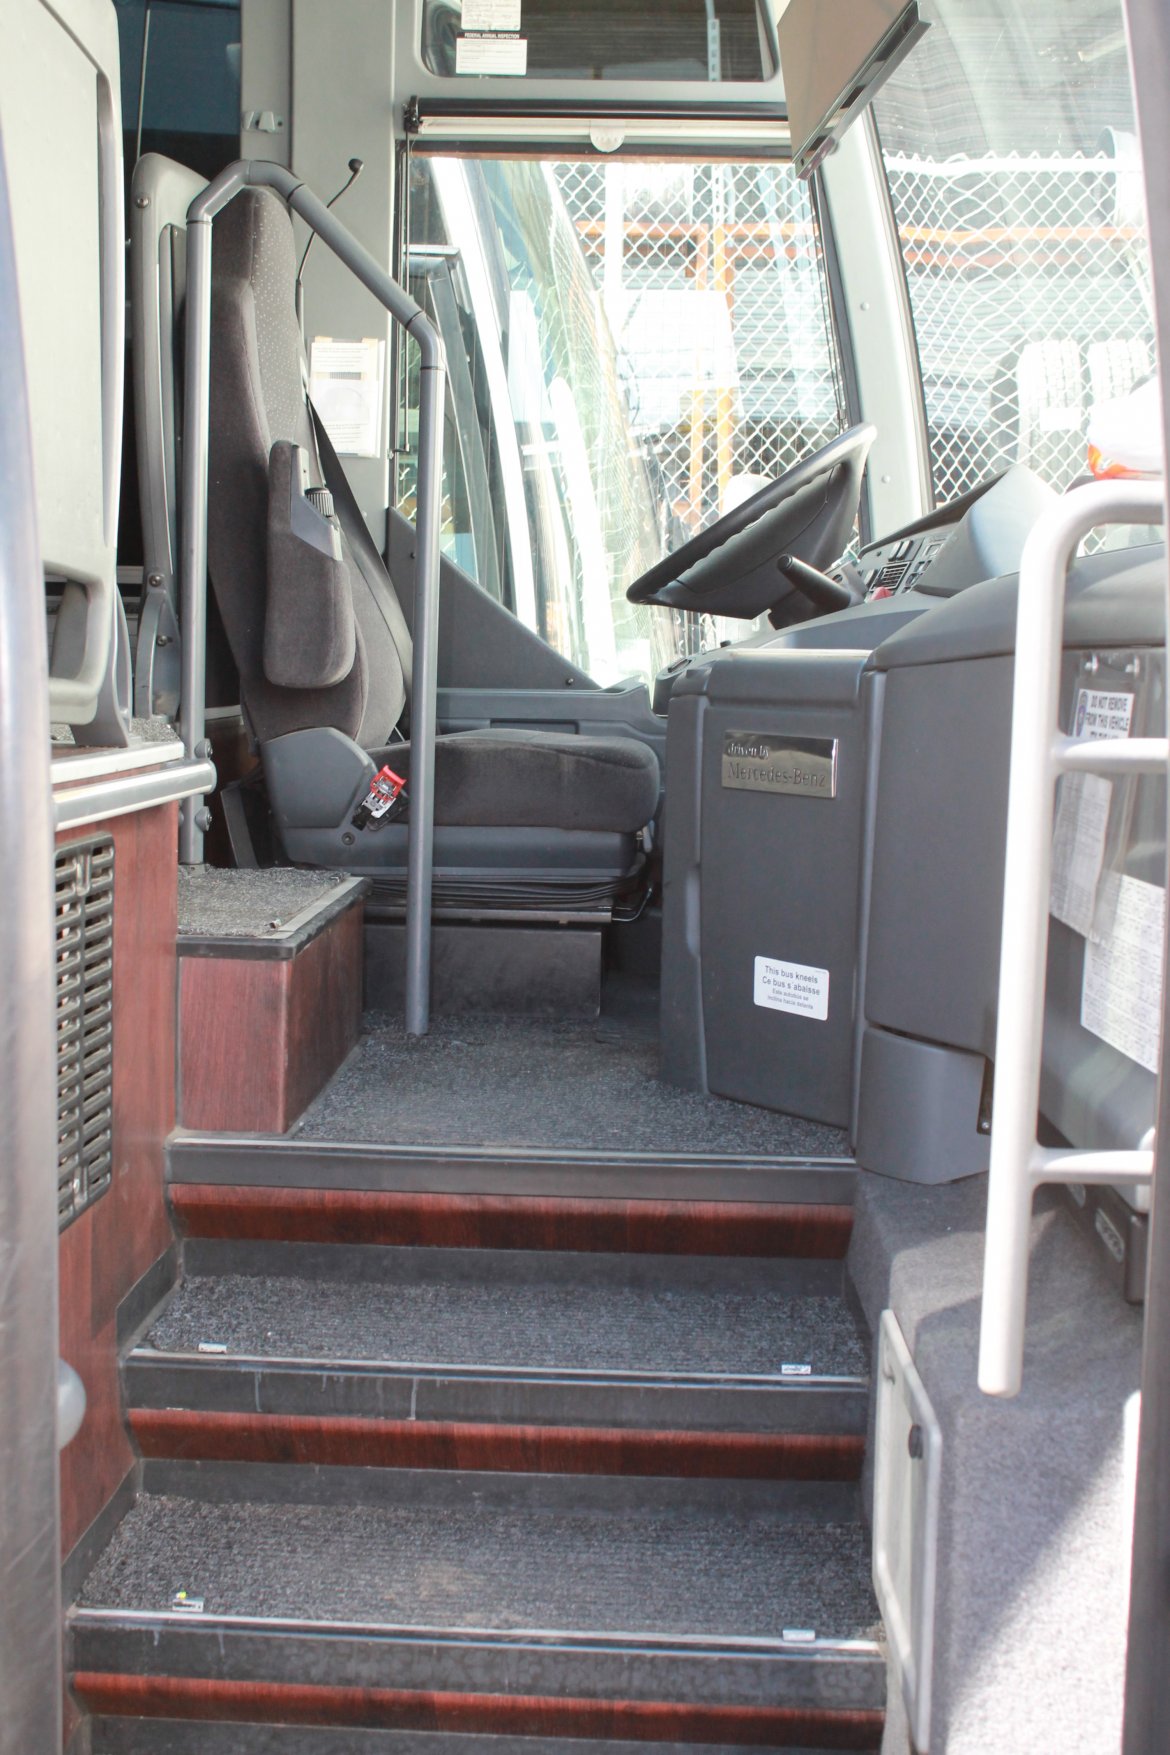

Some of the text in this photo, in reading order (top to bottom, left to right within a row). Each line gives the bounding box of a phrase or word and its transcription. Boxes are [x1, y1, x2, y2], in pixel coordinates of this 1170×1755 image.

[1091, 695, 1128, 712] DO NOT REMOVE
[1086, 712, 1130, 732] FROM THIS VEHICLE
[728, 761, 825, 787] Mercedes-Benz
[762, 975, 772, 985] Ce
[773, 978, 786, 988] bus
[765, 965, 779, 976] This
[781, 968, 794, 979] bus
[795, 972, 818, 983] kneels
